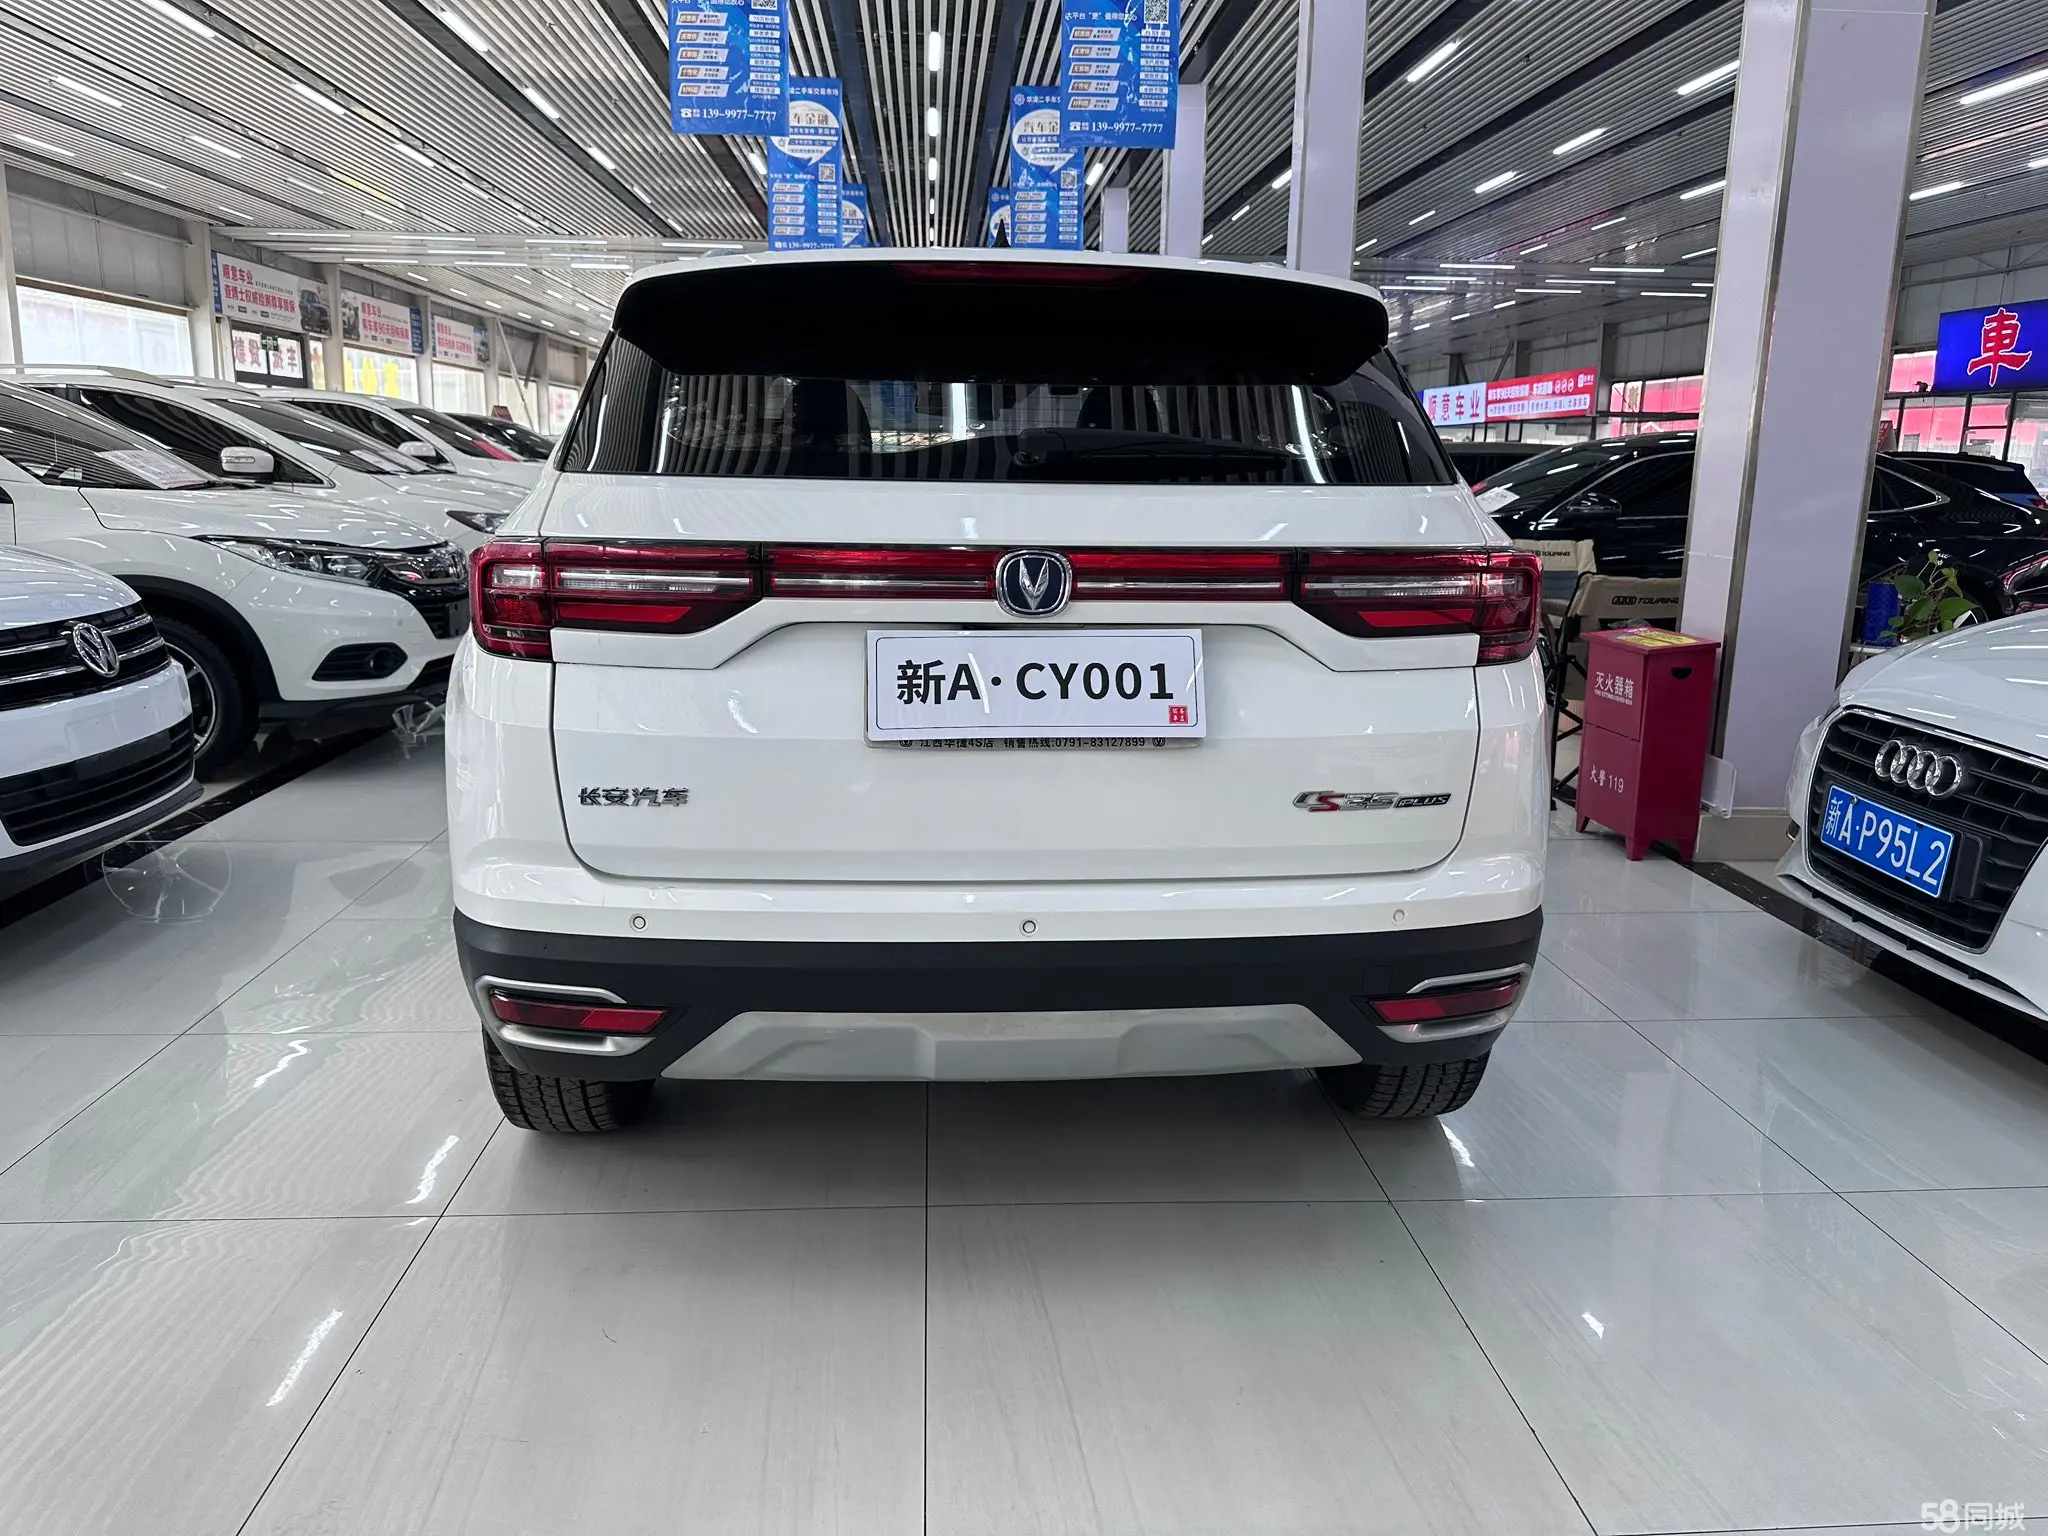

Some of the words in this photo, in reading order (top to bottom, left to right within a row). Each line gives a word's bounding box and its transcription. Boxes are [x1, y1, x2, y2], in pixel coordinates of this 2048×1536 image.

[703, 109, 777, 121] 139-9977-7777
[1092, 121, 1164, 133] 139-9977-7777
[1967, 307, 2033, 388] 車
[1594, 671, 1635, 699] 灭火器箱
[1003, 737, 1146, 749] 销售热线:0791-83127899
[1608, 774, 1624, 793] 119
[577, 786, 689, 807] 长安汽车
[1396, 795, 1450, 808] PLUS
